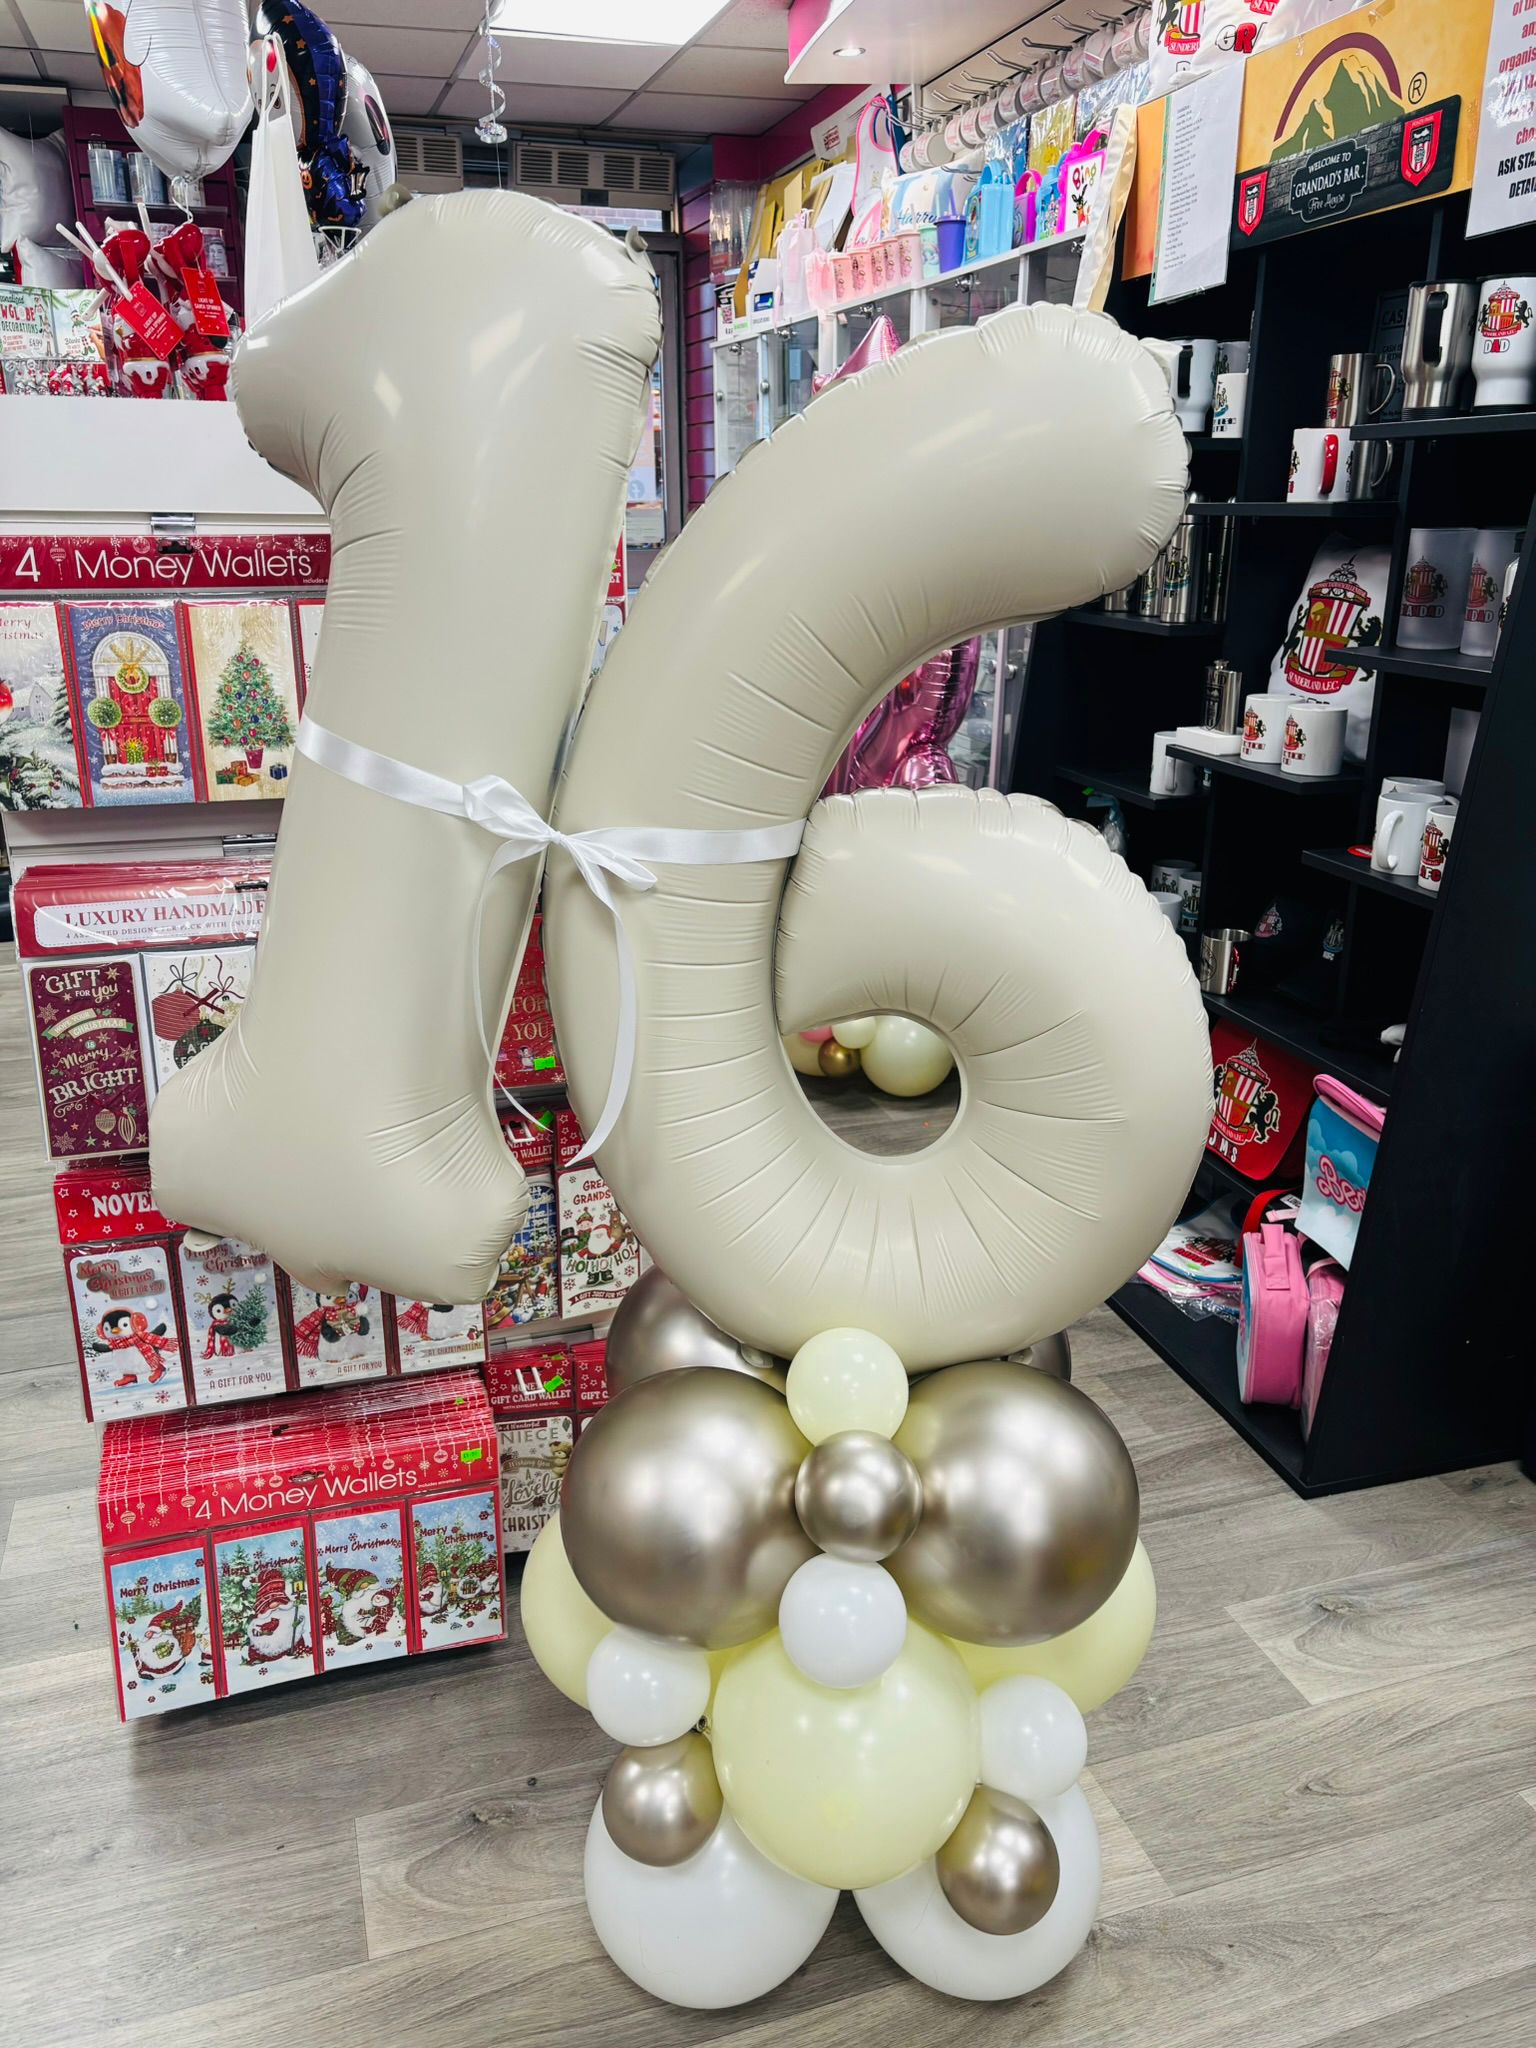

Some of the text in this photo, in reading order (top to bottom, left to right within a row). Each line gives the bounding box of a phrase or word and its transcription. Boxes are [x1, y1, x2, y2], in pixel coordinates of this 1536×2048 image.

[1308, 152, 1352, 173] WELCOME TO
[1498, 155, 1516, 177] ASK
[1072, 162, 1097, 190] Bing
[1295, 164, 1361, 198] GRANDAD'S BAR
[1484, 338, 1510, 354] DAD
[15, 546, 312, 585] 4 Money Wallets
[1288, 671, 1321, 691] SUNDERLAND
[65, 907, 147, 928] LUXURY
[45, 969, 101, 994] GIFT
[75, 982, 119, 1003] FOR you
[58, 1048, 109, 1069] Merry
[187, 1043, 197, 1054] A
[49, 1067, 137, 1104] BRIGHT
[520, 1145, 553, 1159] WALLET
[337, 1359, 383, 1375] A GIFT FOR YOU
[209, 1371, 272, 1389] A GIFT FOR YOU
[491, 1394, 514, 1405] GIFT
[539, 1388, 571, 1399] WALLET
[580, 1390, 601, 1400] GIFT
[501, 1427, 558, 1444] NIECE
[526, 1469, 532, 1480] A
[195, 1467, 418, 1520] 4 Money Wallets
[504, 1473, 562, 1508] Lovely
[324, 1537, 398, 1554] Merry Christmas
[419, 1526, 489, 1545] Merry Christmas
[222, 1555, 300, 1577] Merry Christmas
[120, 1577, 200, 1598] Merry Christmas
